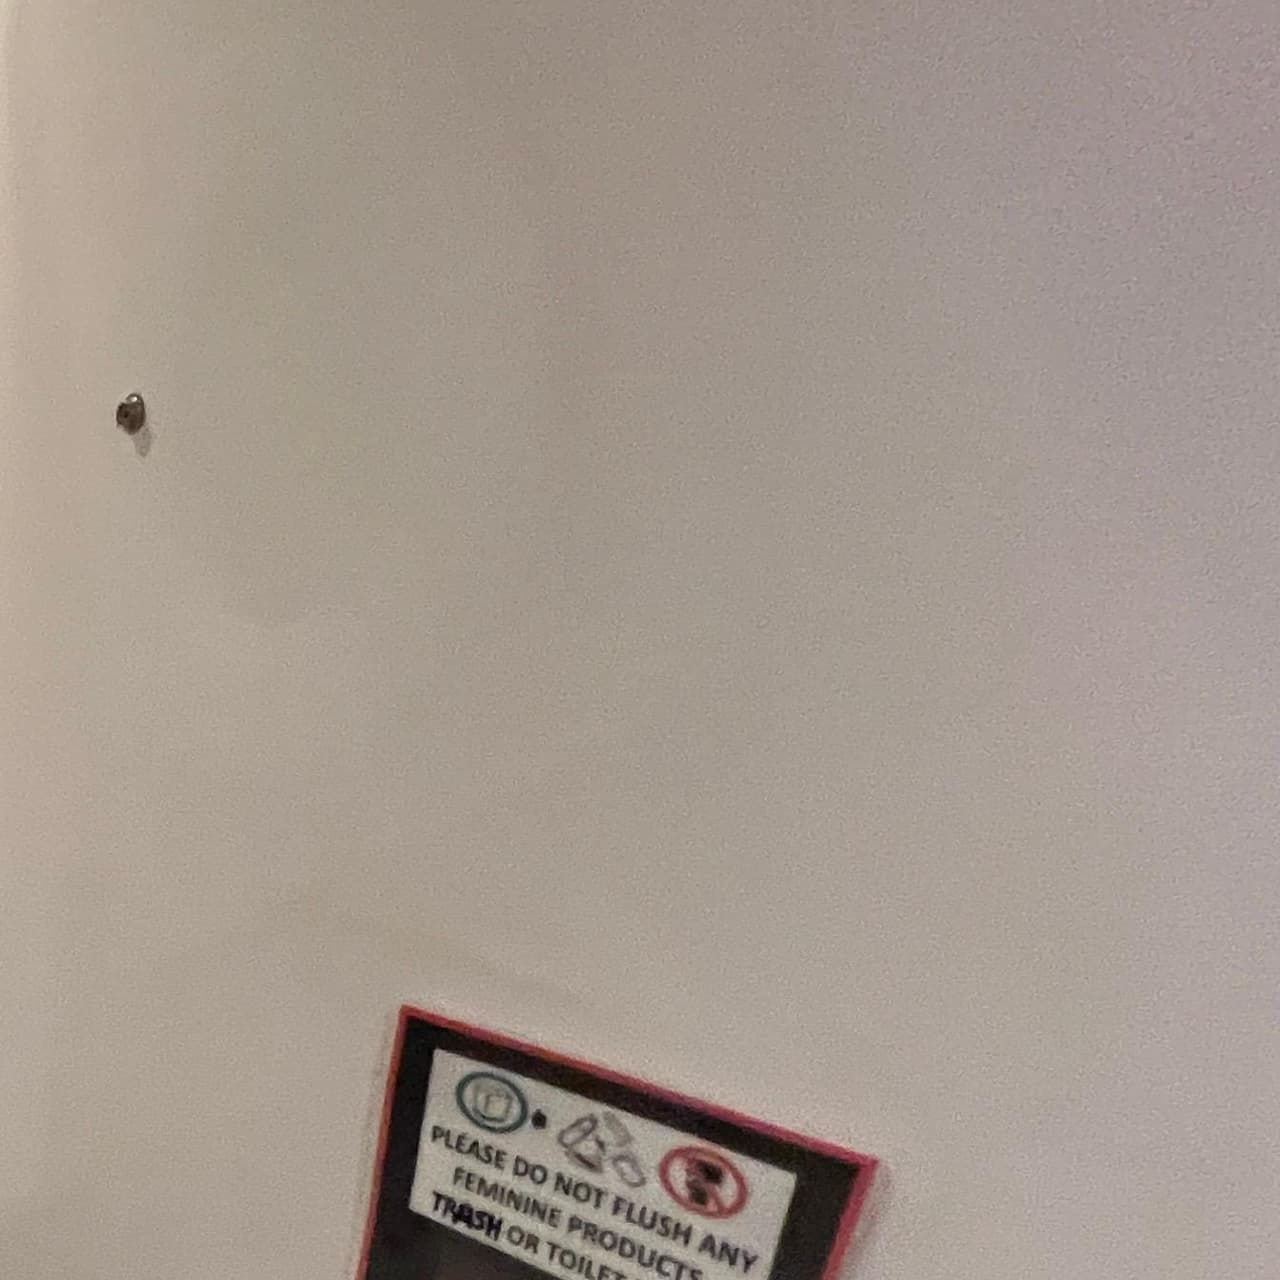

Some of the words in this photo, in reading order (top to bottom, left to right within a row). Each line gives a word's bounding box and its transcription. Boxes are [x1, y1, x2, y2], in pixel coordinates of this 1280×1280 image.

[431, 1125, 507, 1170] PLEASE
[513, 1154, 548, 1185] DO
[554, 1171, 607, 1209] NOT
[612, 1195, 693, 1245] FLUSH
[699, 1233, 759, 1274] ANY
[432, 1190, 503, 1242] TRASH
[506, 1225, 540, 1253] OR
[453, 1165, 561, 1228] FEMININE
